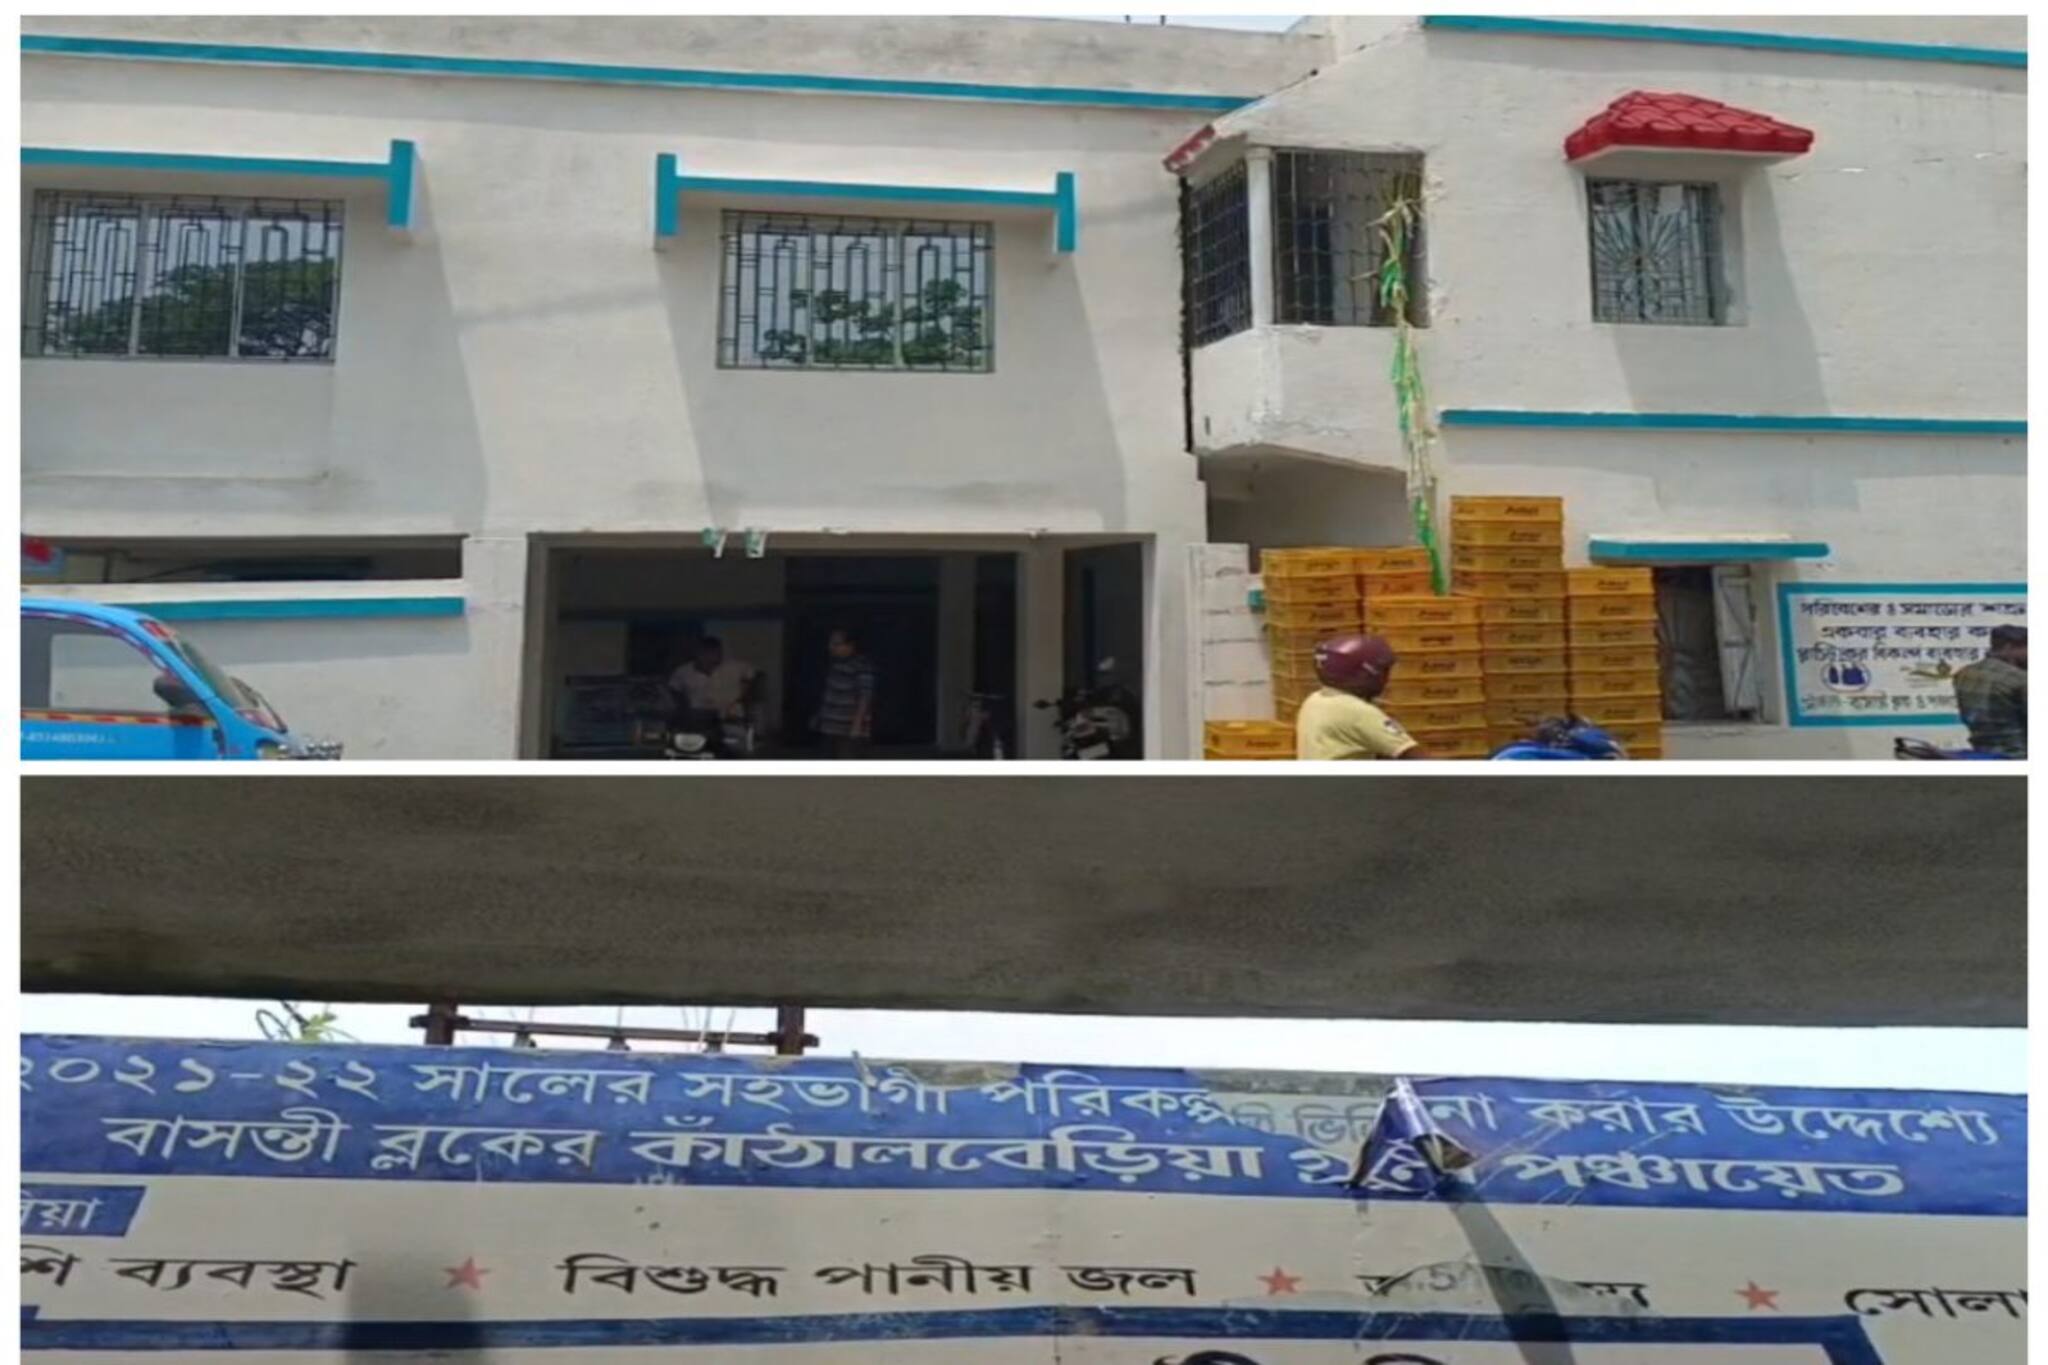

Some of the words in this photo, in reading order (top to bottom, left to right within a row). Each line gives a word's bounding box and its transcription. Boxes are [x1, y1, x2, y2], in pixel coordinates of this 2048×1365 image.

[410, 1061, 655, 1105] সালের
[1513, 1096, 1706, 1135] করার
[100, 1106, 352, 1162] বাসন্তী
[372, 1124, 603, 1171] ব্লকের
[630, 1114, 1264, 1183] কাঁঠালবেড়িয়া
[1501, 1151, 1905, 1199] পঞ্চায়েত
[108, 1257, 357, 1300] ব্যবস্থা
[556, 1252, 787, 1298] বিশুদ্ধ
[814, 1254, 1037, 1297] পানীয়
[1059, 1264, 1199, 1297] জল
[1845, 1286, 2028, 1319] সোল
